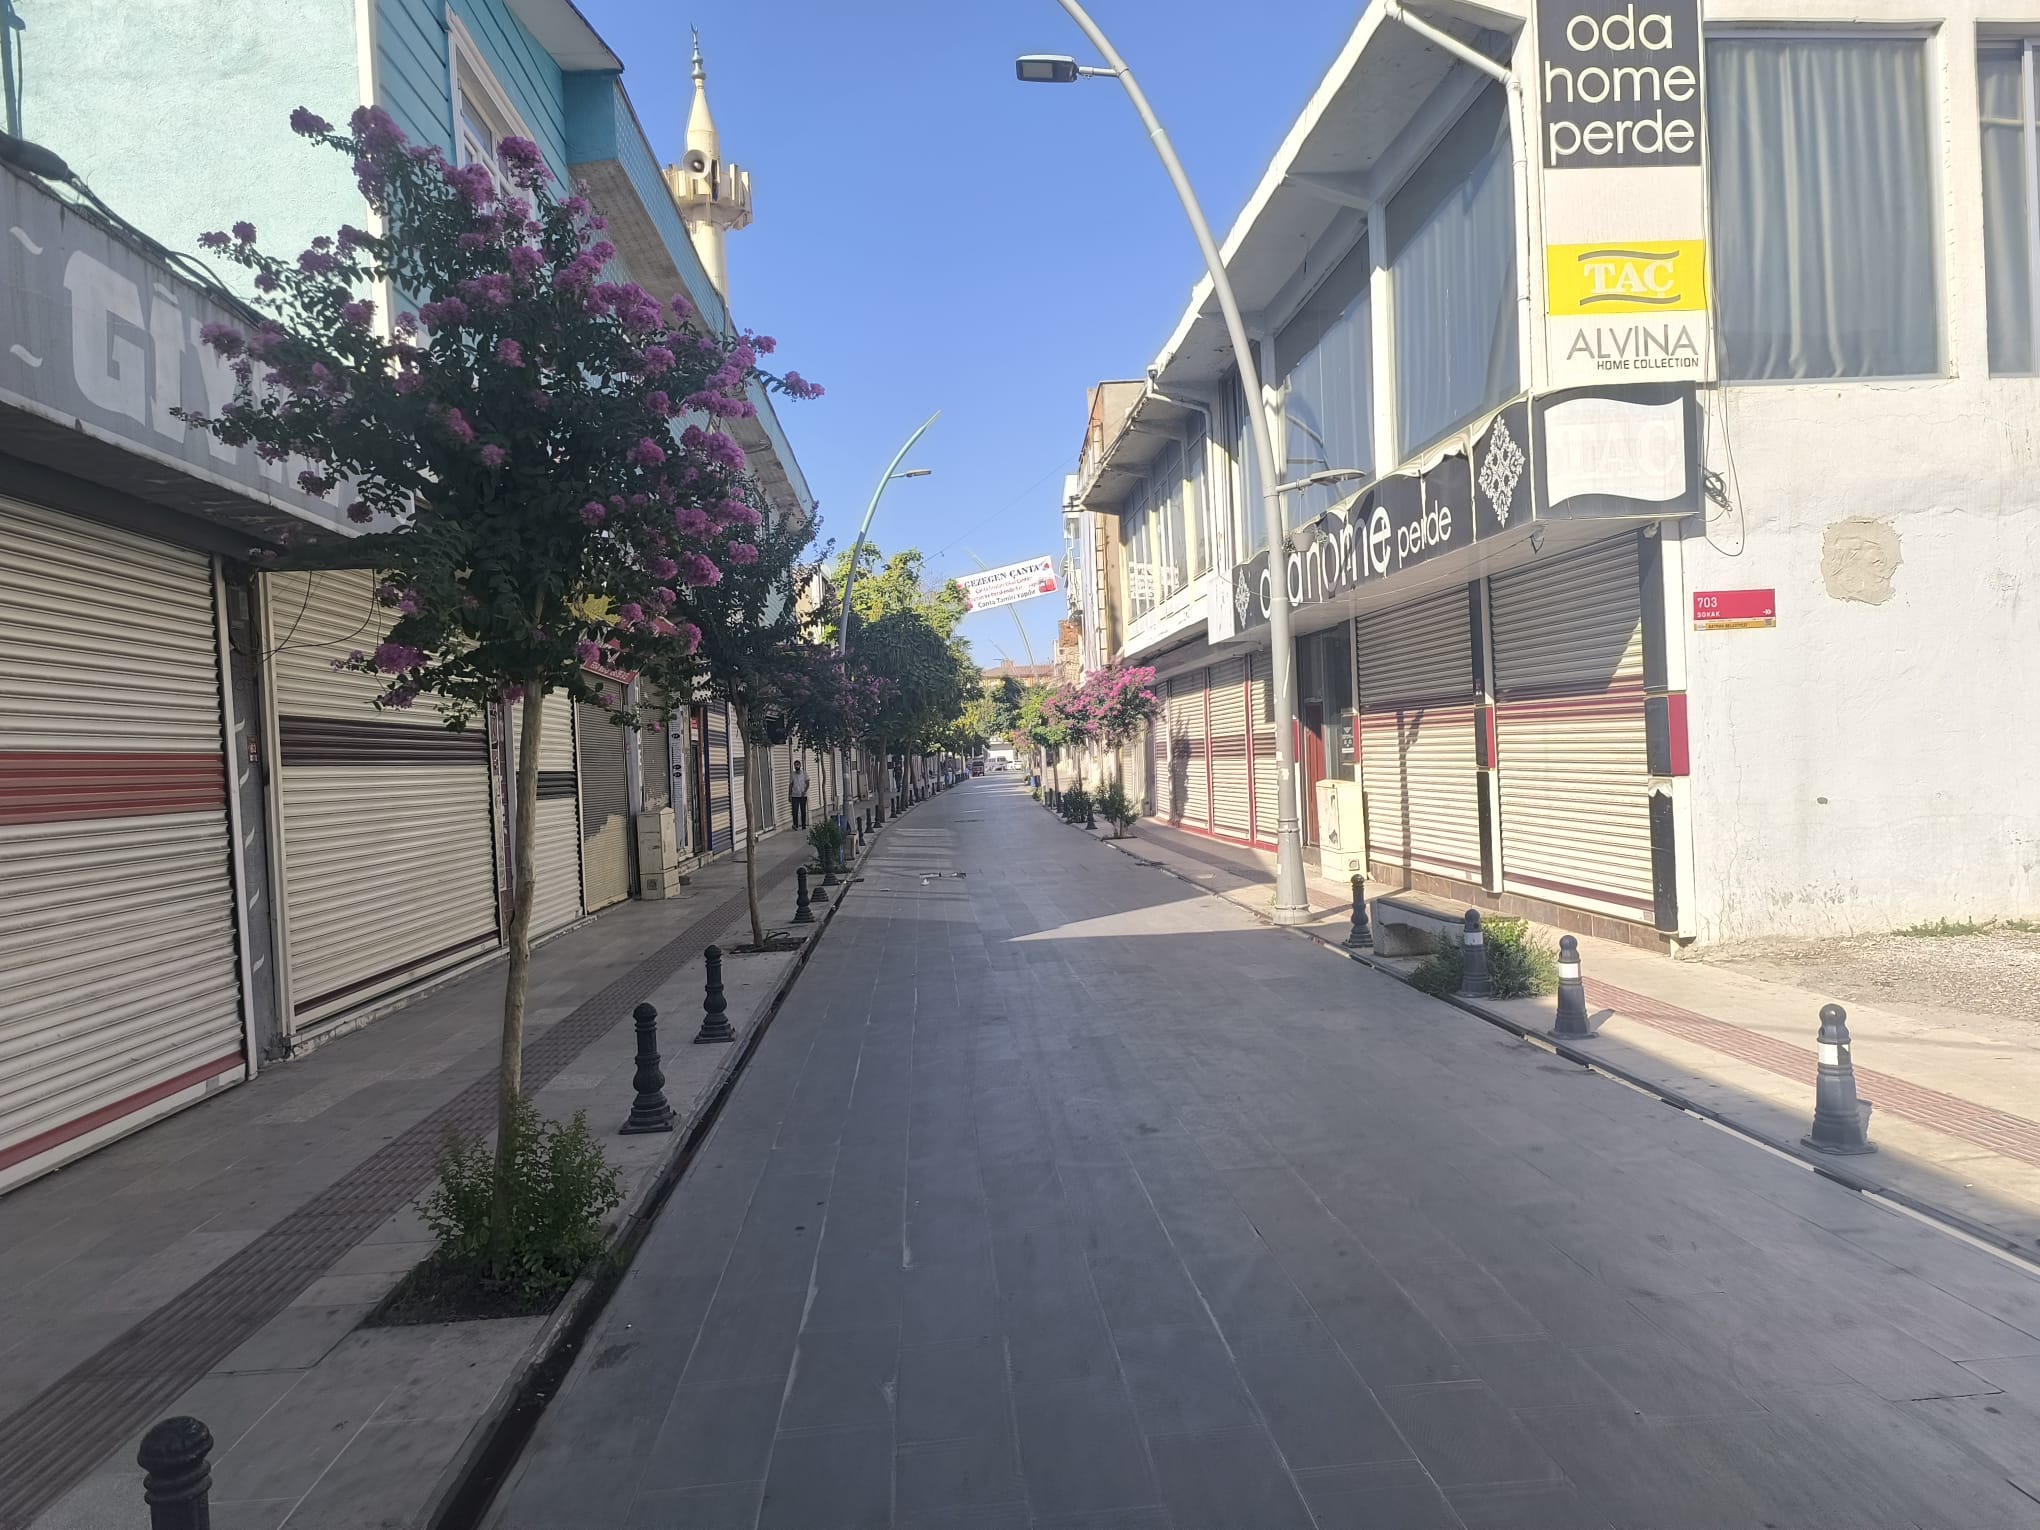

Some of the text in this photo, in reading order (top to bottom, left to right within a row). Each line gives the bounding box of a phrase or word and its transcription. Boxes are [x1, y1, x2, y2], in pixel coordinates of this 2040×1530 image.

[1566, 3, 1673, 51] oda
[1545, 60, 1697, 103] home
[1549, 108, 1695, 167] perde
[1566, 323, 1699, 361] ALVINA
[1597, 357, 1699, 371] HOME COLLECTION
[1009, 563, 1039, 579] ÇANTA
[1697, 596, 1718, 608] 703
